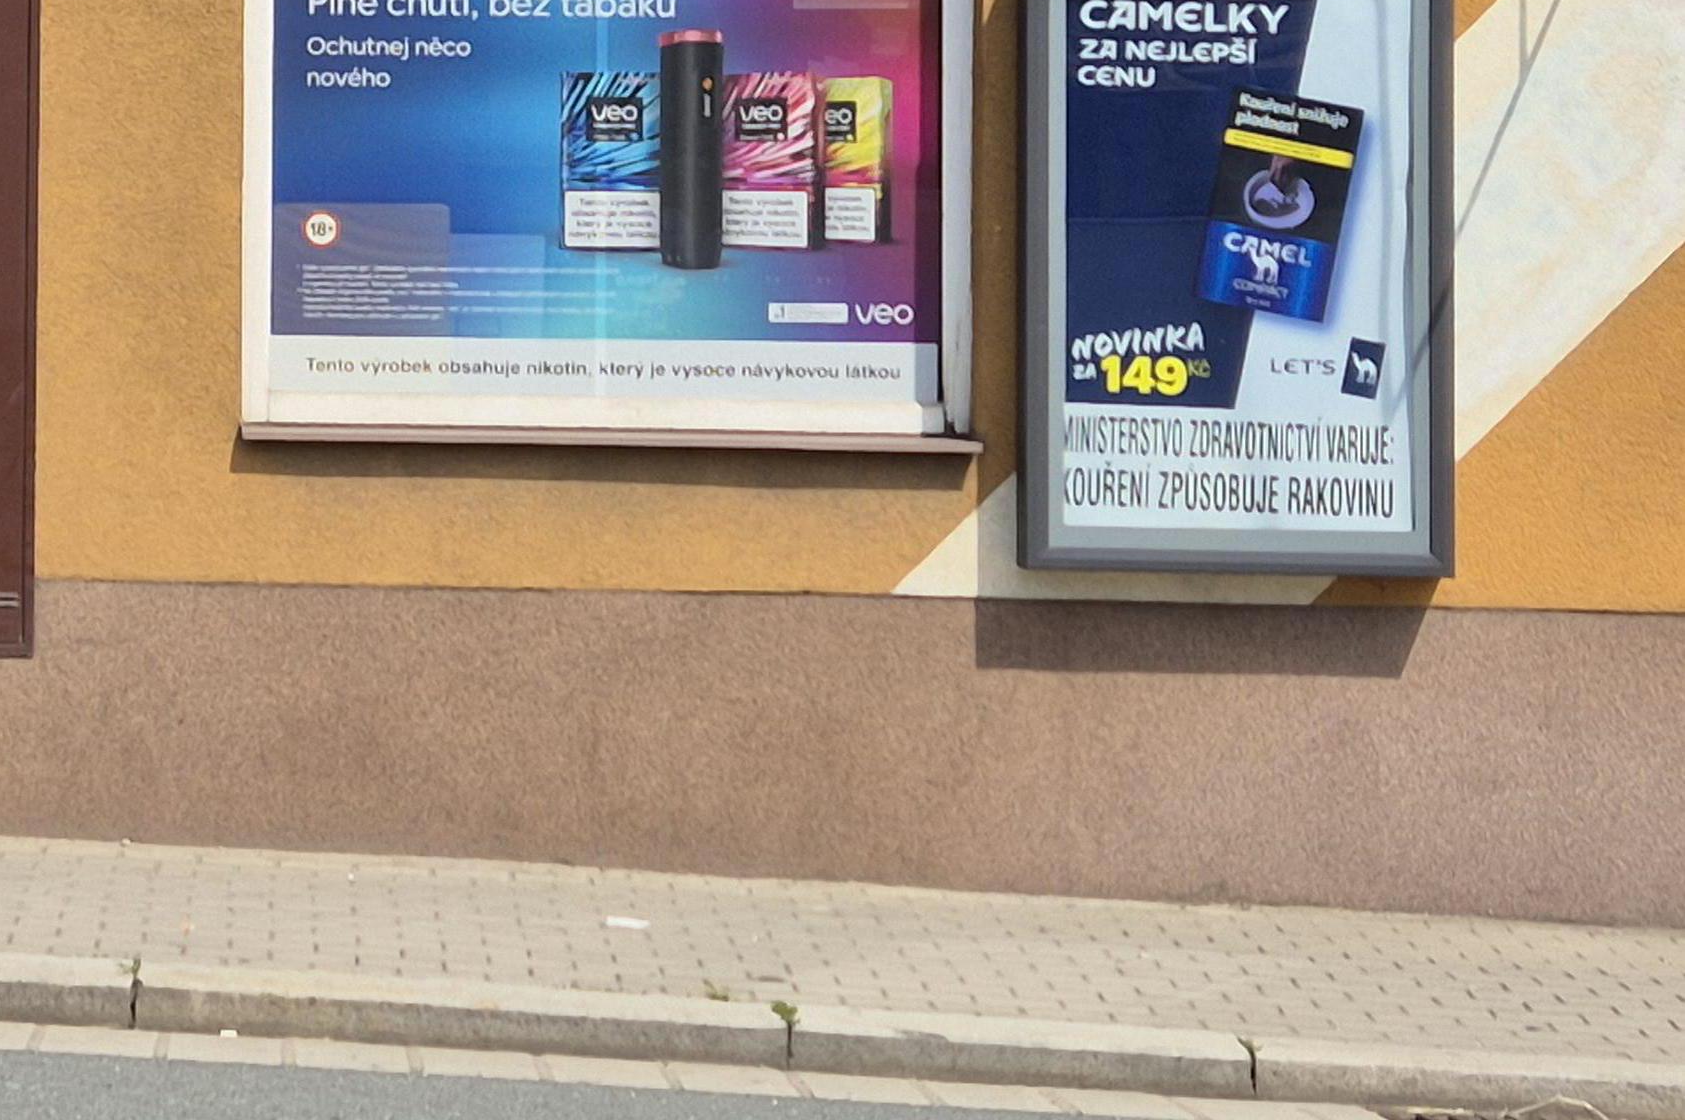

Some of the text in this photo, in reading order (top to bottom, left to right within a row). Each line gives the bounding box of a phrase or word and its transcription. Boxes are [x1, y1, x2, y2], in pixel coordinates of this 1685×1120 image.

[1079, 0, 1289, 35] CAMELKY
[307, 36, 471, 61] Ochutnej něco
[1079, 38, 1257, 64] ZA NEJLEPŠÍ
[307, 67, 391, 88] nového
[1077, 65, 1156, 88] CENU
[591, 104, 639, 122] veo
[739, 105, 783, 122] veo
[825, 108, 853, 125] eo
[1223, 231, 1312, 268] CAMEL
[855, 303, 915, 325] veo
[1071, 321, 1206, 361] NOVINKA
[307, 358, 902, 381] Tento výrobek obsahuje nikotin, který je vysoce návykovou látkou
[1072, 363, 1097, 380] ZA
[1100, 354, 1188, 396] 149
[1269, 356, 1336, 376] LET'S
[1189, 416, 1322, 463] ZDRAVOTNICTVÍ
[1327, 423, 1395, 466] VARUJE:
[1158, 463, 1280, 515] ZPŮSOBUJE
[1287, 477, 1395, 519] RAKOVINU
